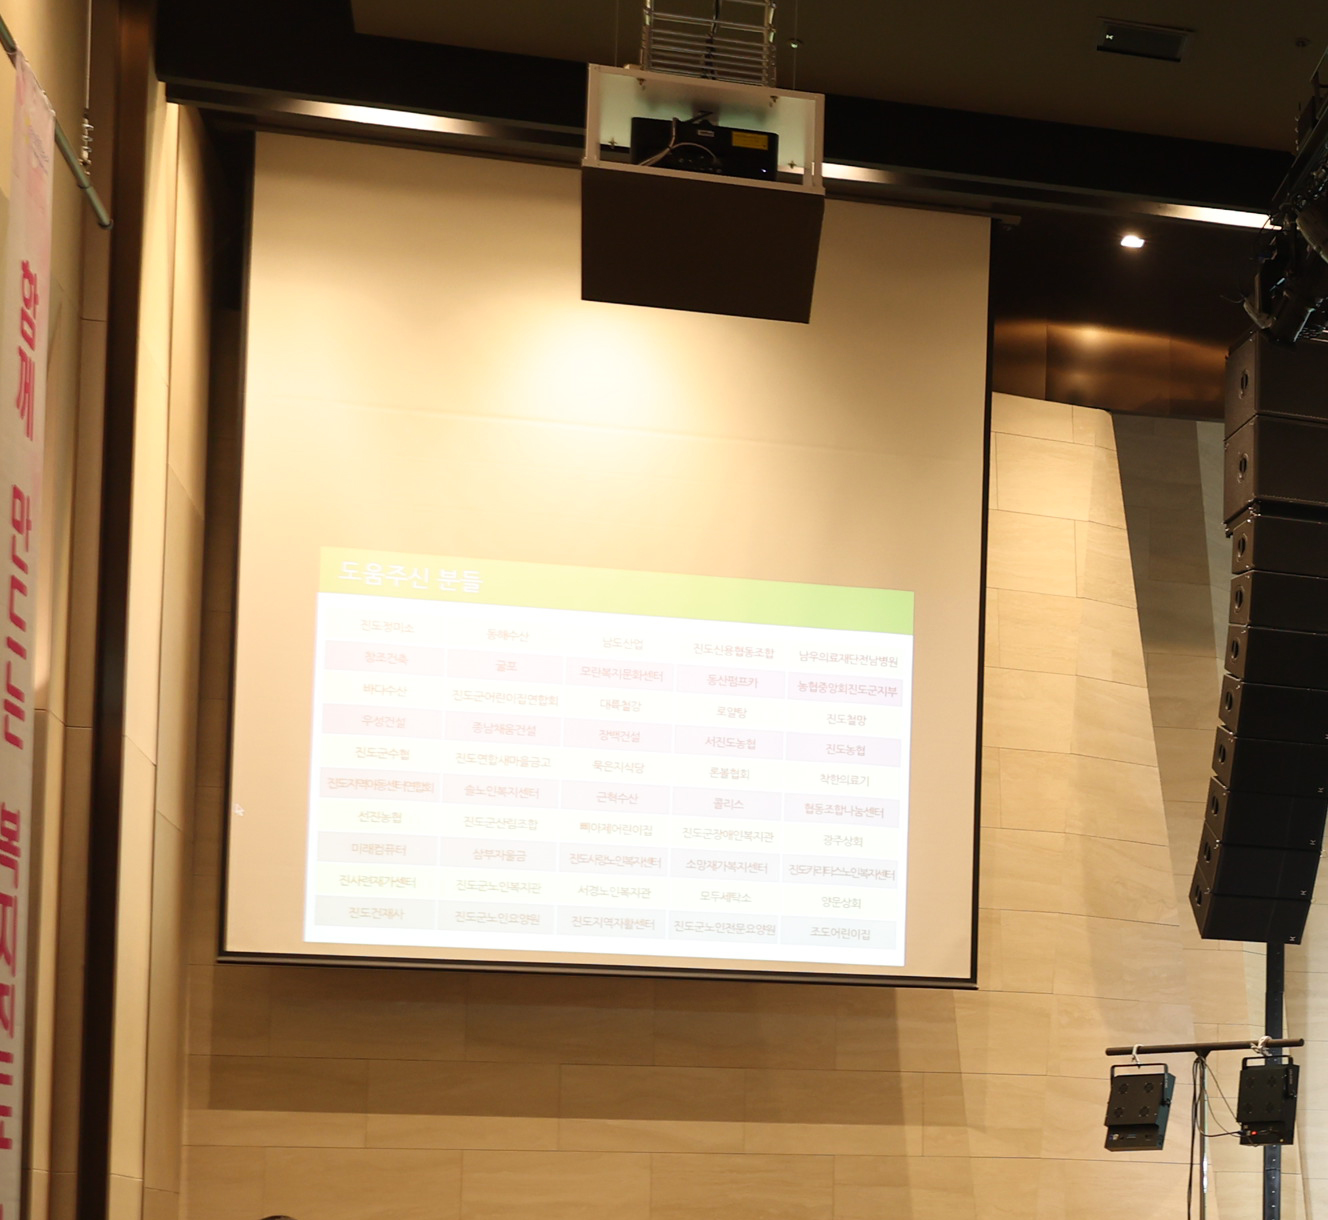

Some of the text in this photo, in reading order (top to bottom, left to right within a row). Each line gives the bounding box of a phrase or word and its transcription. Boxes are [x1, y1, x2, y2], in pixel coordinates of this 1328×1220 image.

[15, 257, 40, 442] 함께
[339, 559, 484, 593] 도움주신 분들
[3, 483, 33, 751] 만드는
[705, 736, 756, 750] 서진도농협
[826, 744, 865, 756] 진도농협
